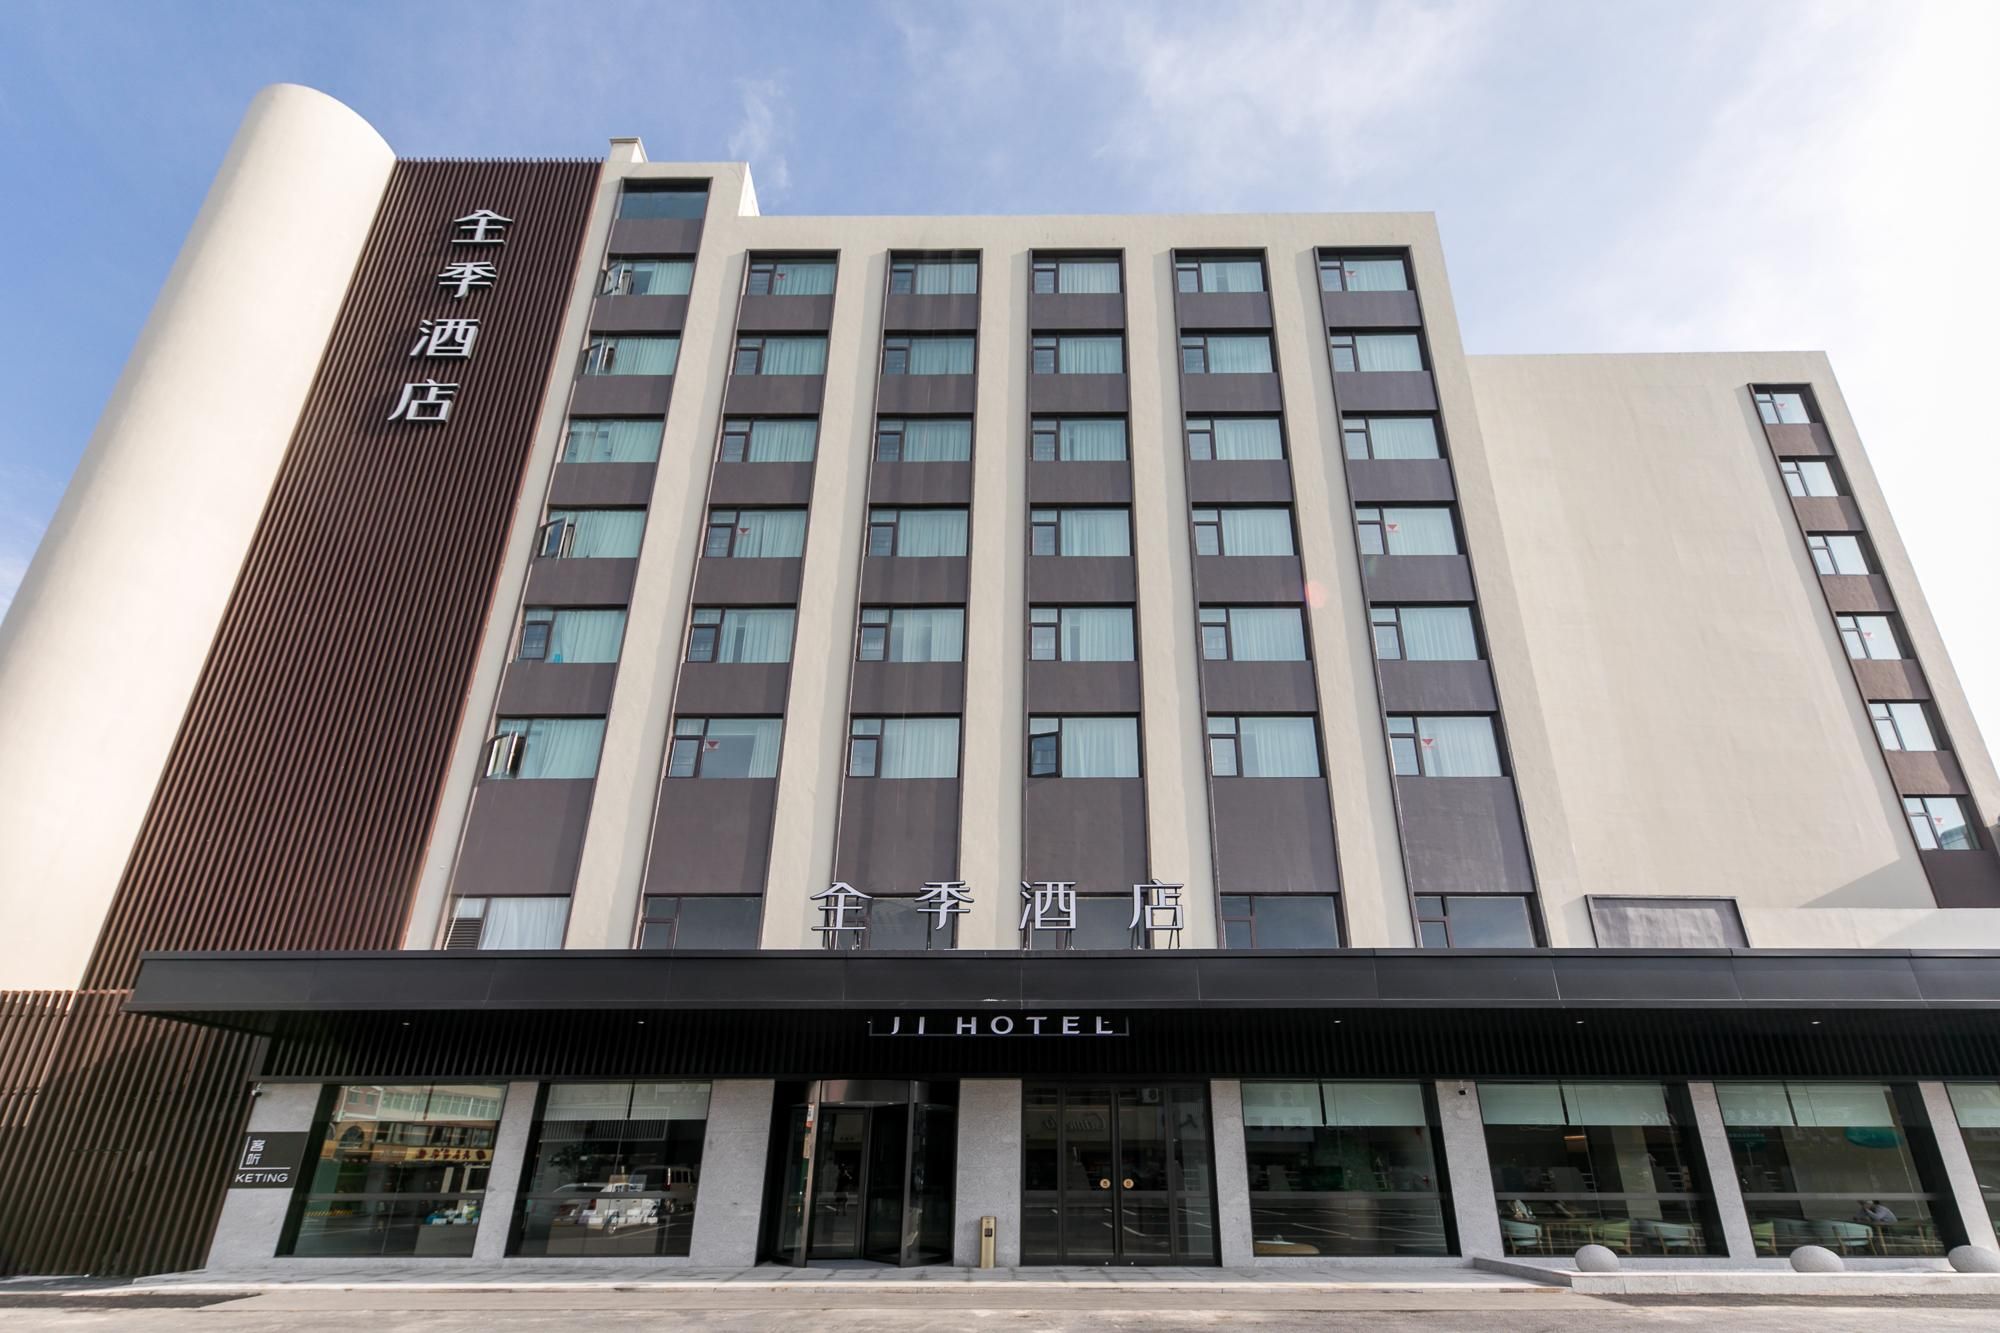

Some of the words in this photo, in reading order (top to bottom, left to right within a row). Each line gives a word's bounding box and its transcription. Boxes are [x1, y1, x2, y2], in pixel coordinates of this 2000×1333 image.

[388, 209, 514, 422] 全季酒店
[810, 880, 1185, 931] 全季酒店
[890, 1016, 926, 1035] JI
[956, 1016, 1114, 1035] HOTEL
[234, 1173, 289, 1183] KETING
